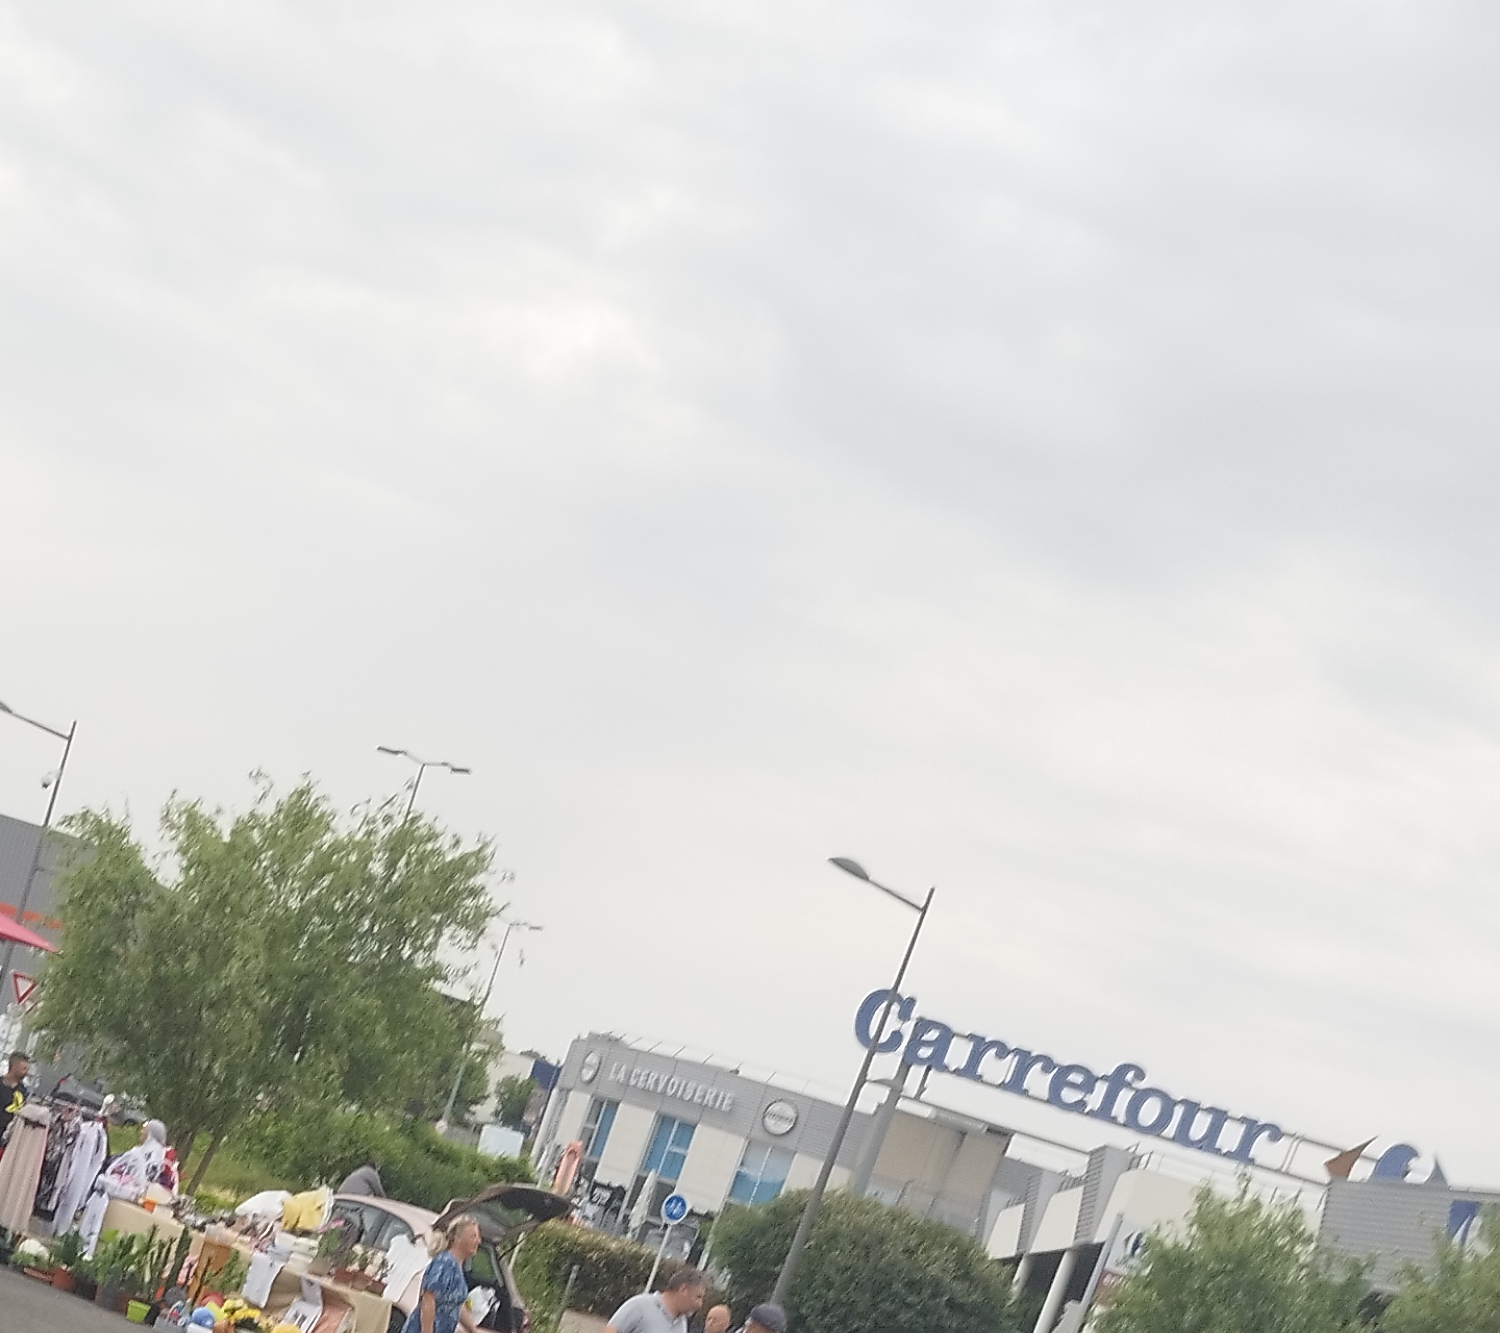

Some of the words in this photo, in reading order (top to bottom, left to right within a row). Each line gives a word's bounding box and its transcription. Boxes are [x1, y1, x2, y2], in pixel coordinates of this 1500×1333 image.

[608, 1062, 626, 1083] LA
[629, 1067, 736, 1113] CERVOISERIE
[854, 988, 1284, 1166] Carrefour
